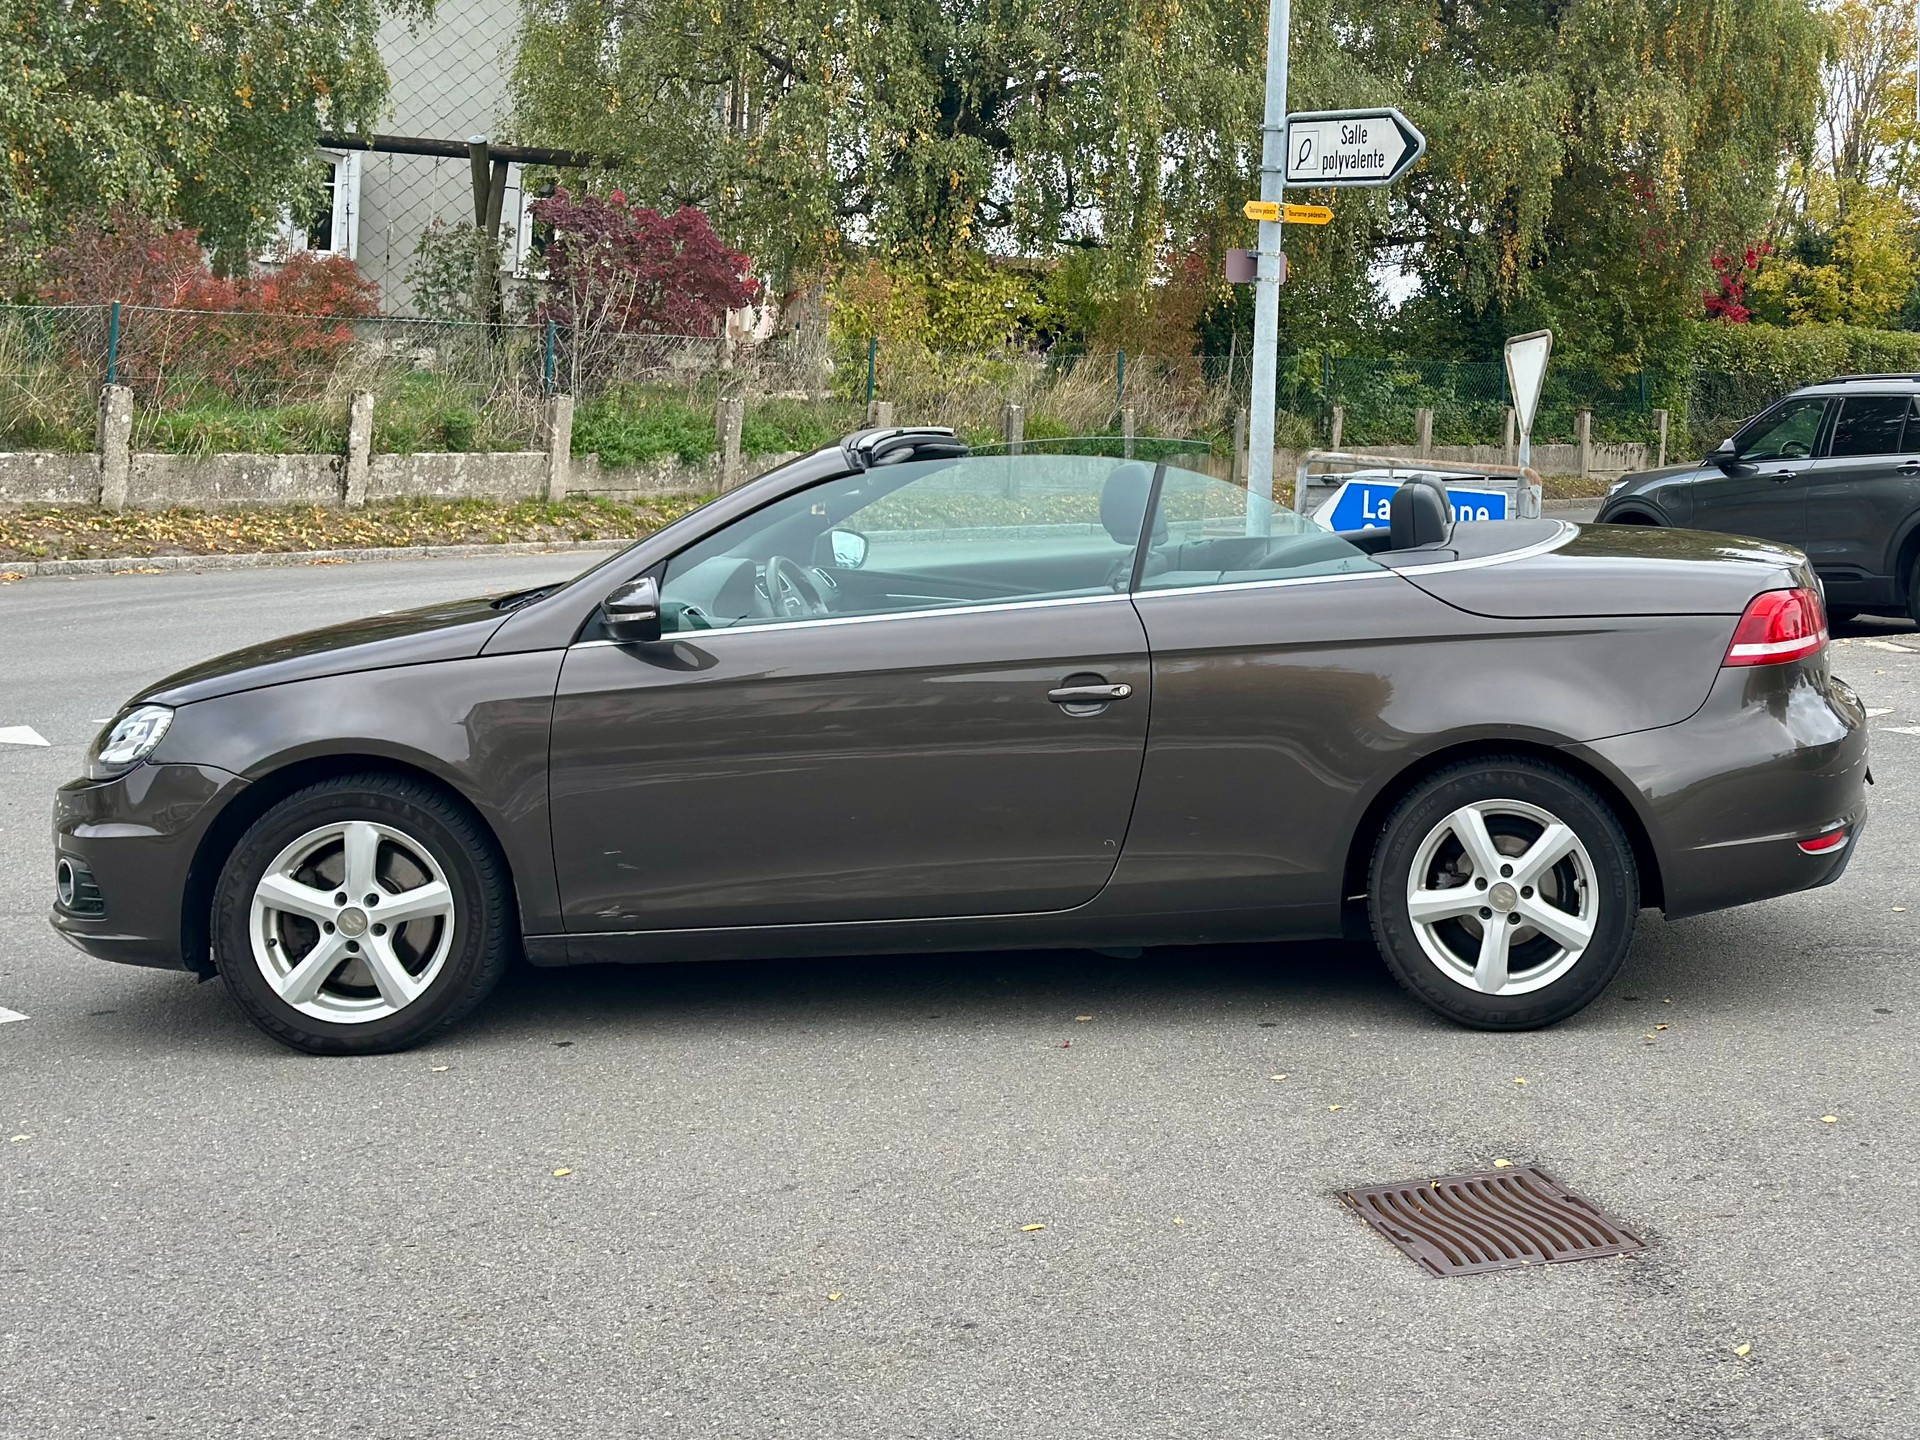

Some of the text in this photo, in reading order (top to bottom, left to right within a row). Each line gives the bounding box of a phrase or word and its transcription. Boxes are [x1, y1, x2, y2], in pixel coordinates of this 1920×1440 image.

[1341, 124, 1368, 145] Salle
[1322, 148, 1385, 175] polyvalente
[1288, 209, 1307, 218] Tourisme
